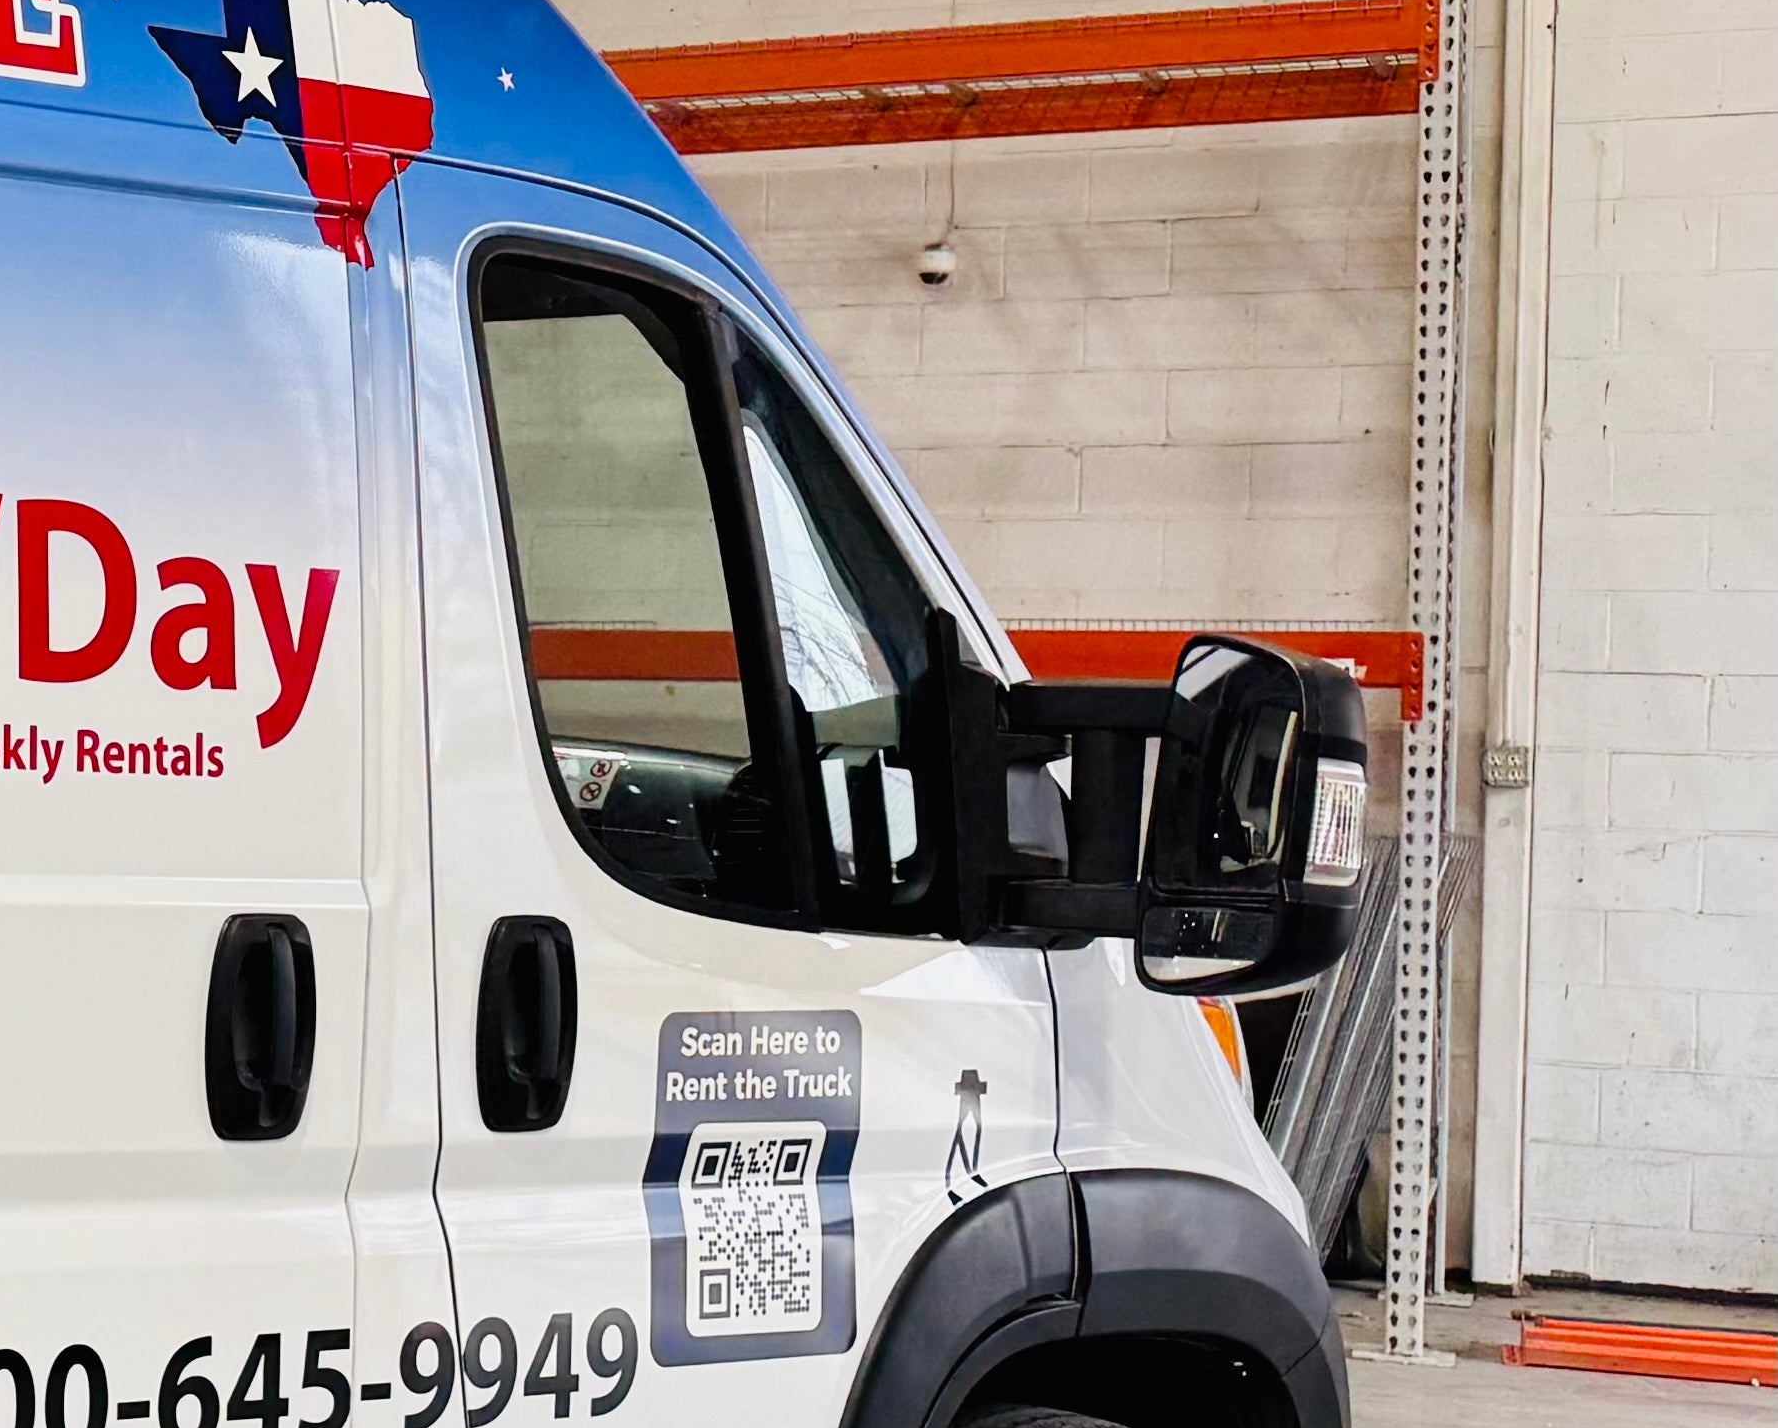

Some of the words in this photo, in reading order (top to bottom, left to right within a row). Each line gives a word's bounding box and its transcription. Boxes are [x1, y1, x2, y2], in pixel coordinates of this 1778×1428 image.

[75, 728, 226, 779] Rentals
[679, 1026, 744, 1058] Scan
[749, 1024, 811, 1057] Here
[813, 1024, 842, 1056] to
[665, 1071, 729, 1103] Rent
[733, 1067, 778, 1101] the
[782, 1064, 854, 1099] Truck
